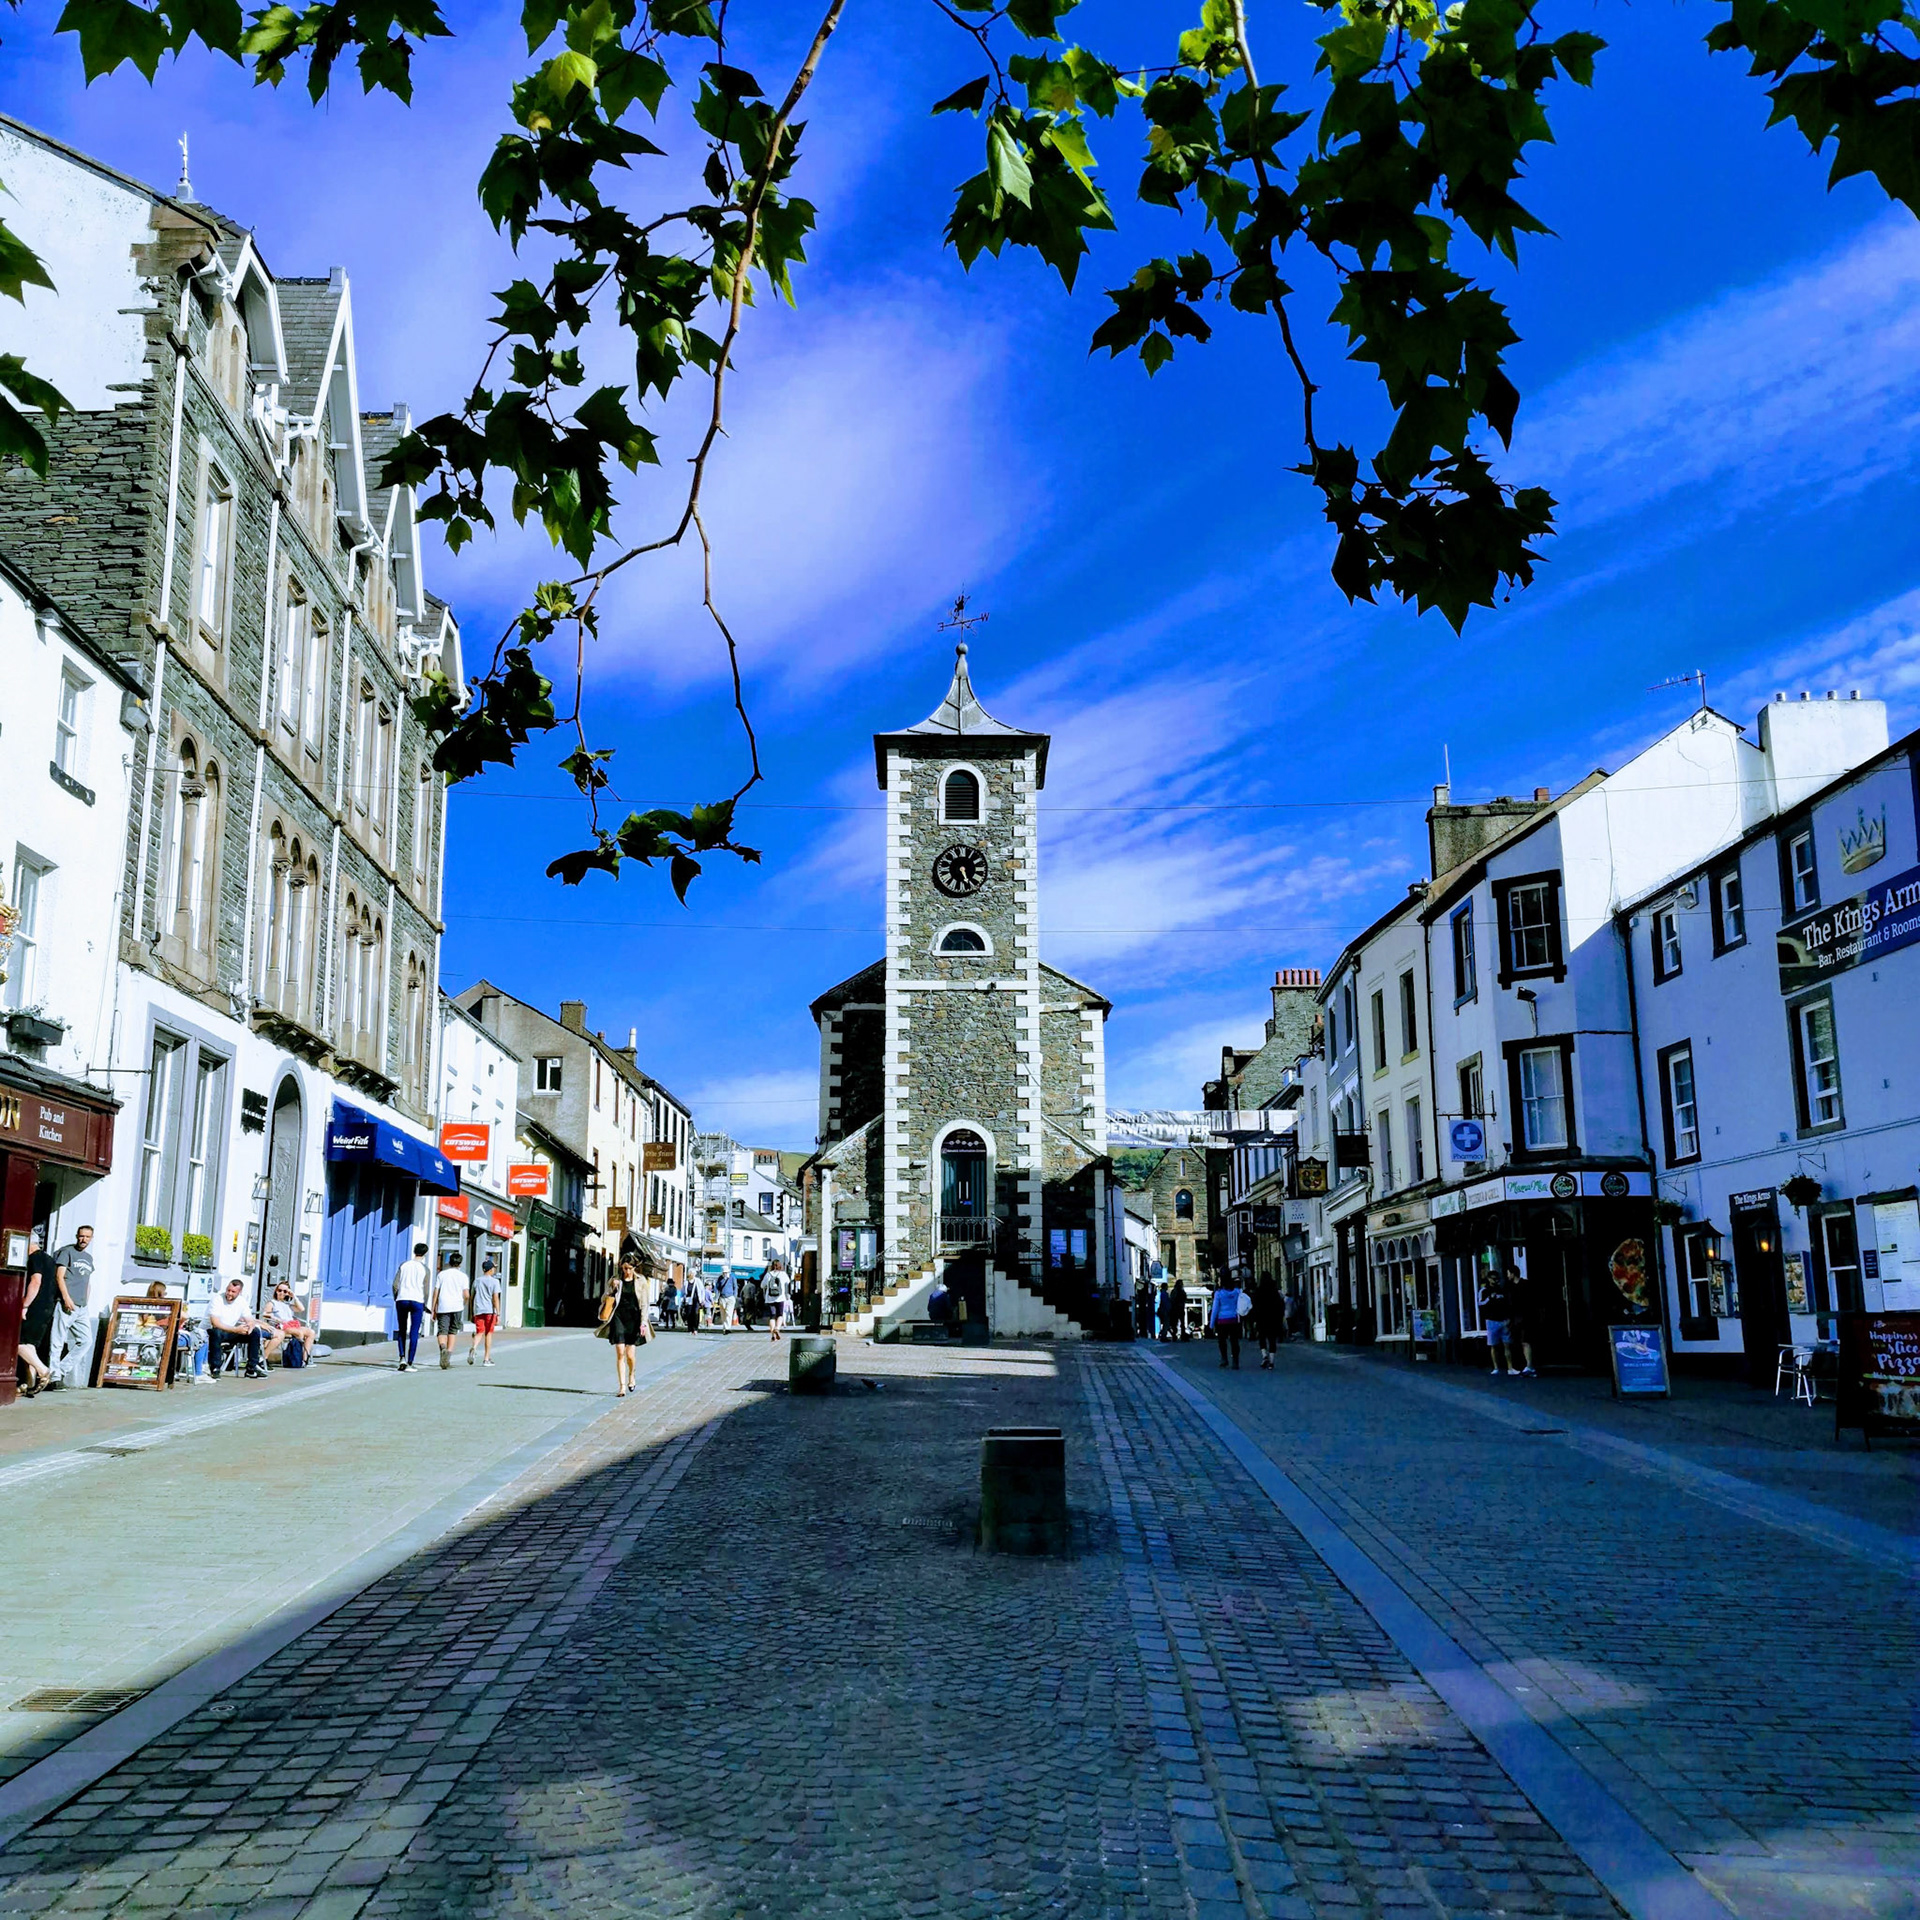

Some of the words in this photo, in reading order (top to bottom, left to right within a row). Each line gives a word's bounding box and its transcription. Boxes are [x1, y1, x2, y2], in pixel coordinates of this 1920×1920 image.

[1803, 920, 1832, 951] The
[1833, 899, 1881, 938] Kings
[1818, 952, 1836, 968] Bar,
[1836, 930, 1883, 962] Restaurant
[1883, 926, 1890, 941] &
[40, 1106, 52, 1121] Pub
[53, 1112, 64, 1125] and
[39, 1125, 63, 1143] Kitchen
[333, 1135, 354, 1145] Weird
[354, 1135, 369, 1145] Fish
[1734, 1195, 1743, 1205] The
[1743, 1193, 1757, 1205] Kings
[1869, 1331, 1918, 1343] Happiness
[1876, 1352, 1920, 1375] Pizza
